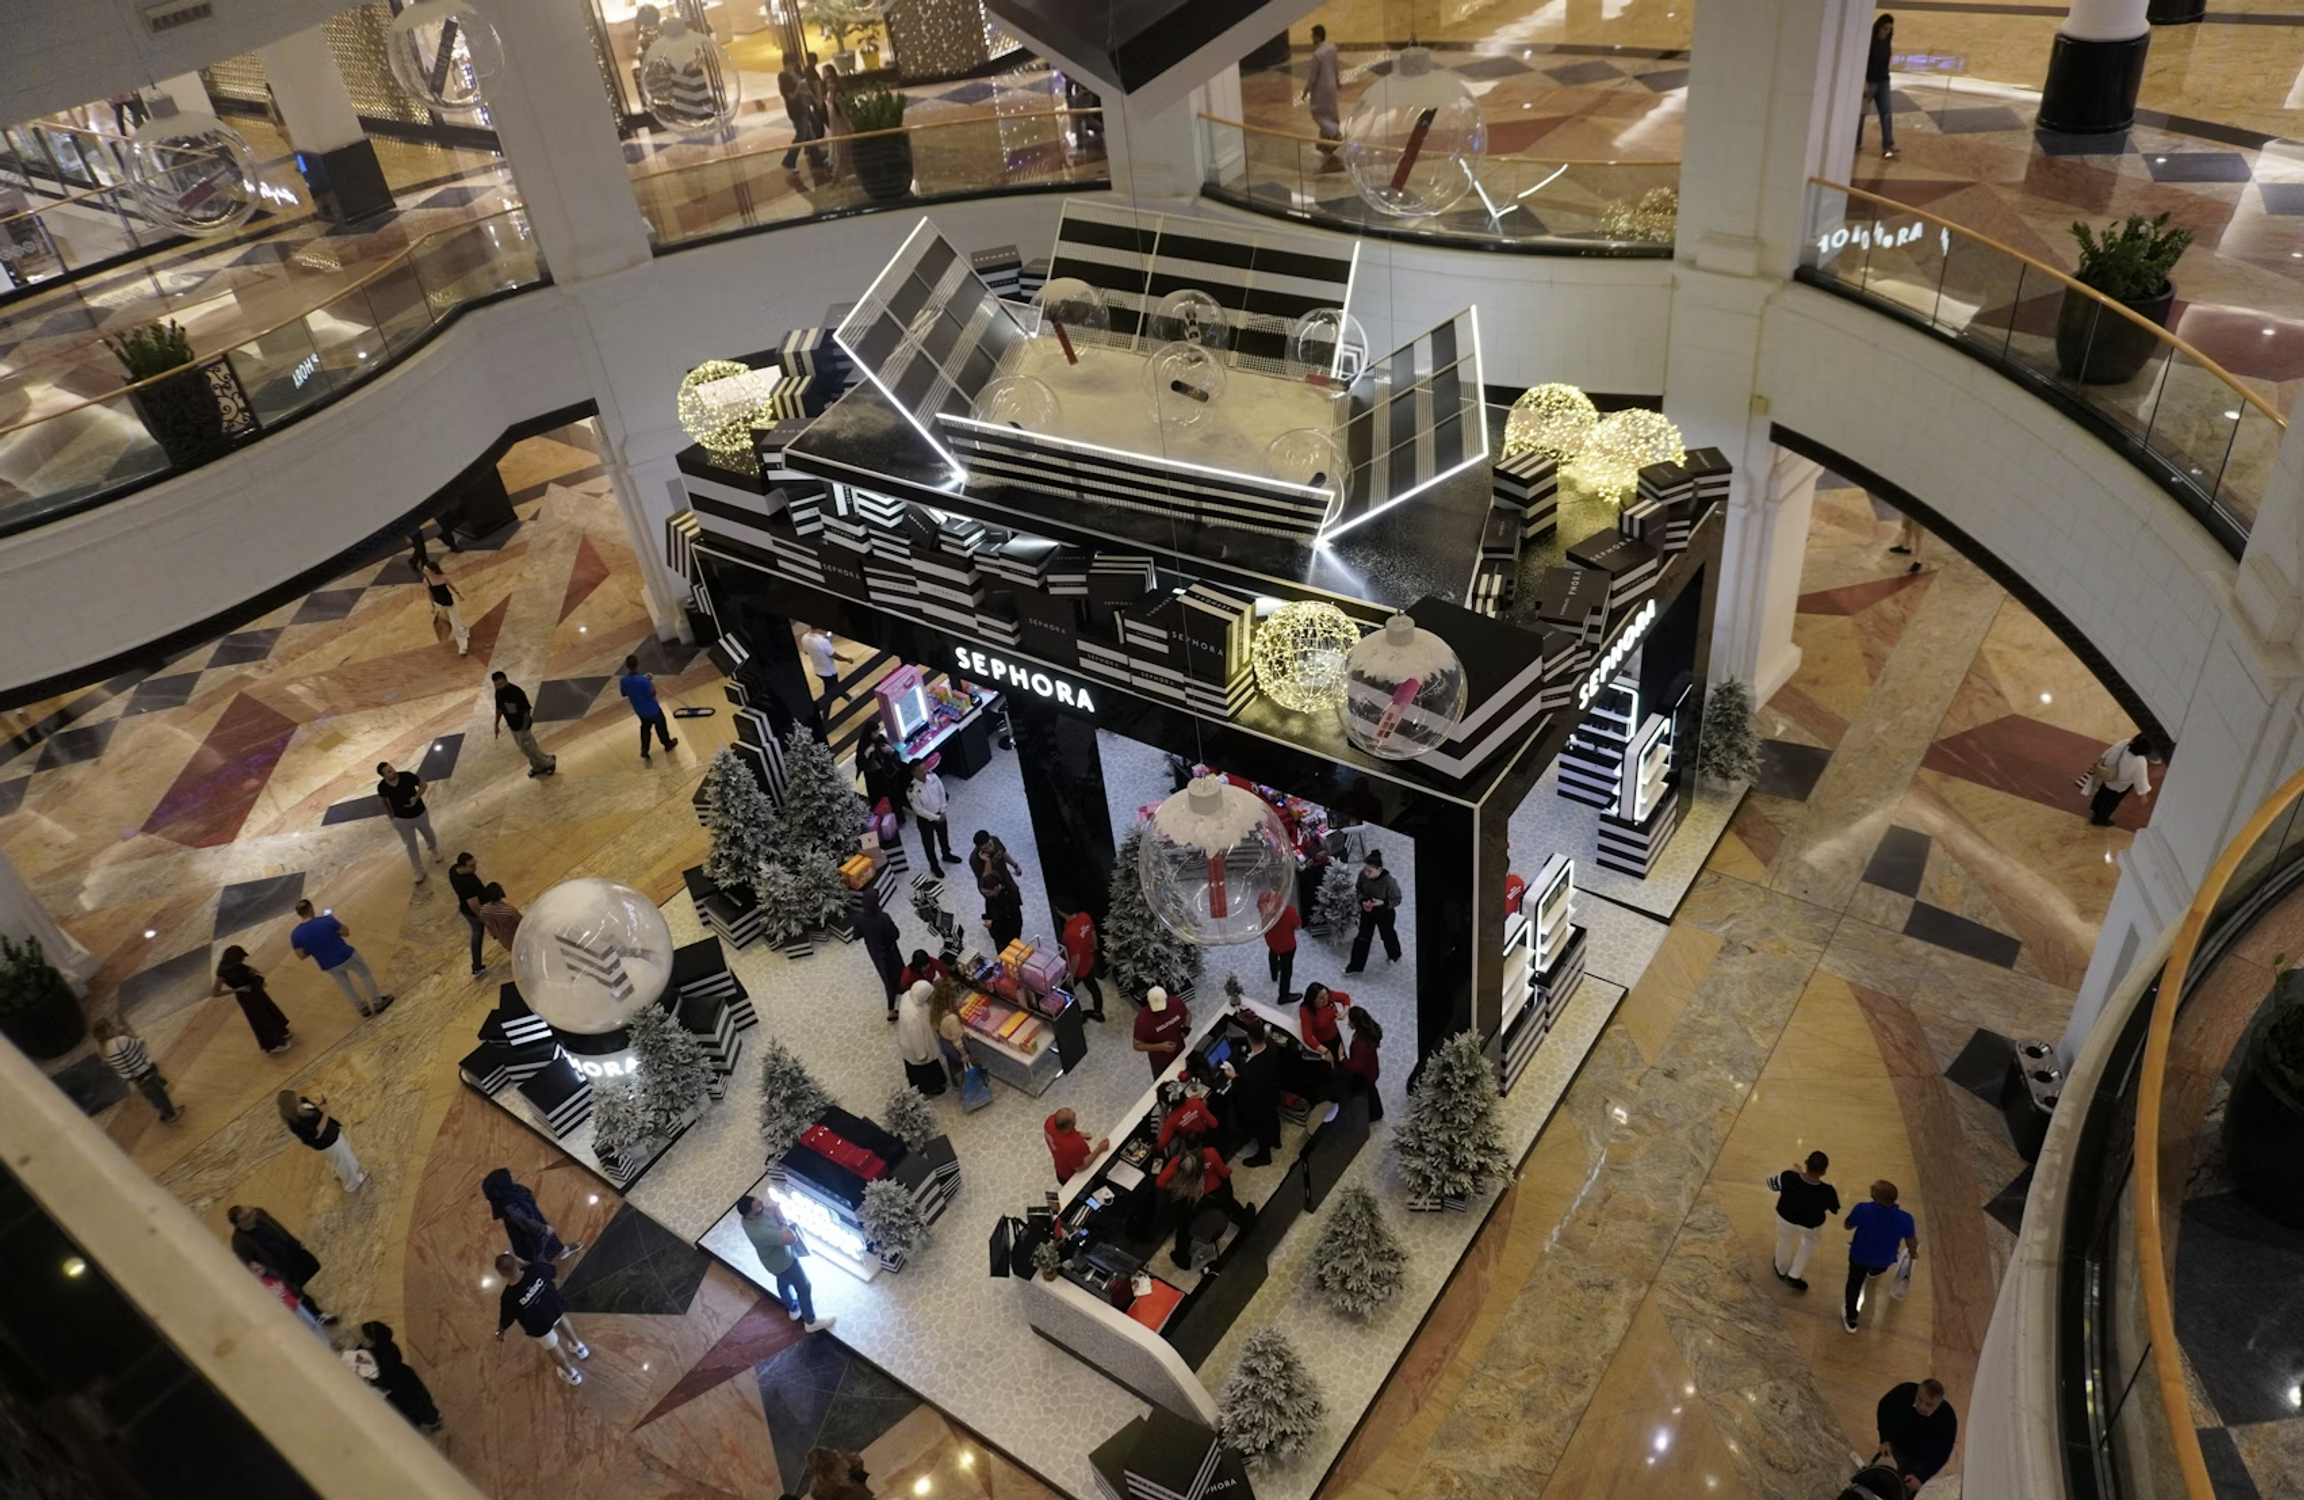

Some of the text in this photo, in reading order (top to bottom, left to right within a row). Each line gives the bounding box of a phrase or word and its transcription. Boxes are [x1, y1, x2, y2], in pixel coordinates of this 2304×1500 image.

[1589, 537, 1634, 561] SEPHORA
[822, 563, 860, 579] SEPHORA
[1028, 617, 1067, 635] SEPHORA
[1172, 631, 1224, 657] SEPHORA
[1578, 599, 1656, 711] SEPHORA
[1087, 653, 1120, 668] SEPHORA
[955, 646, 1096, 713] SEPHORA
[1141, 670, 1175, 686] SEPHORA
[519, 1278, 544, 1306] BASIC
